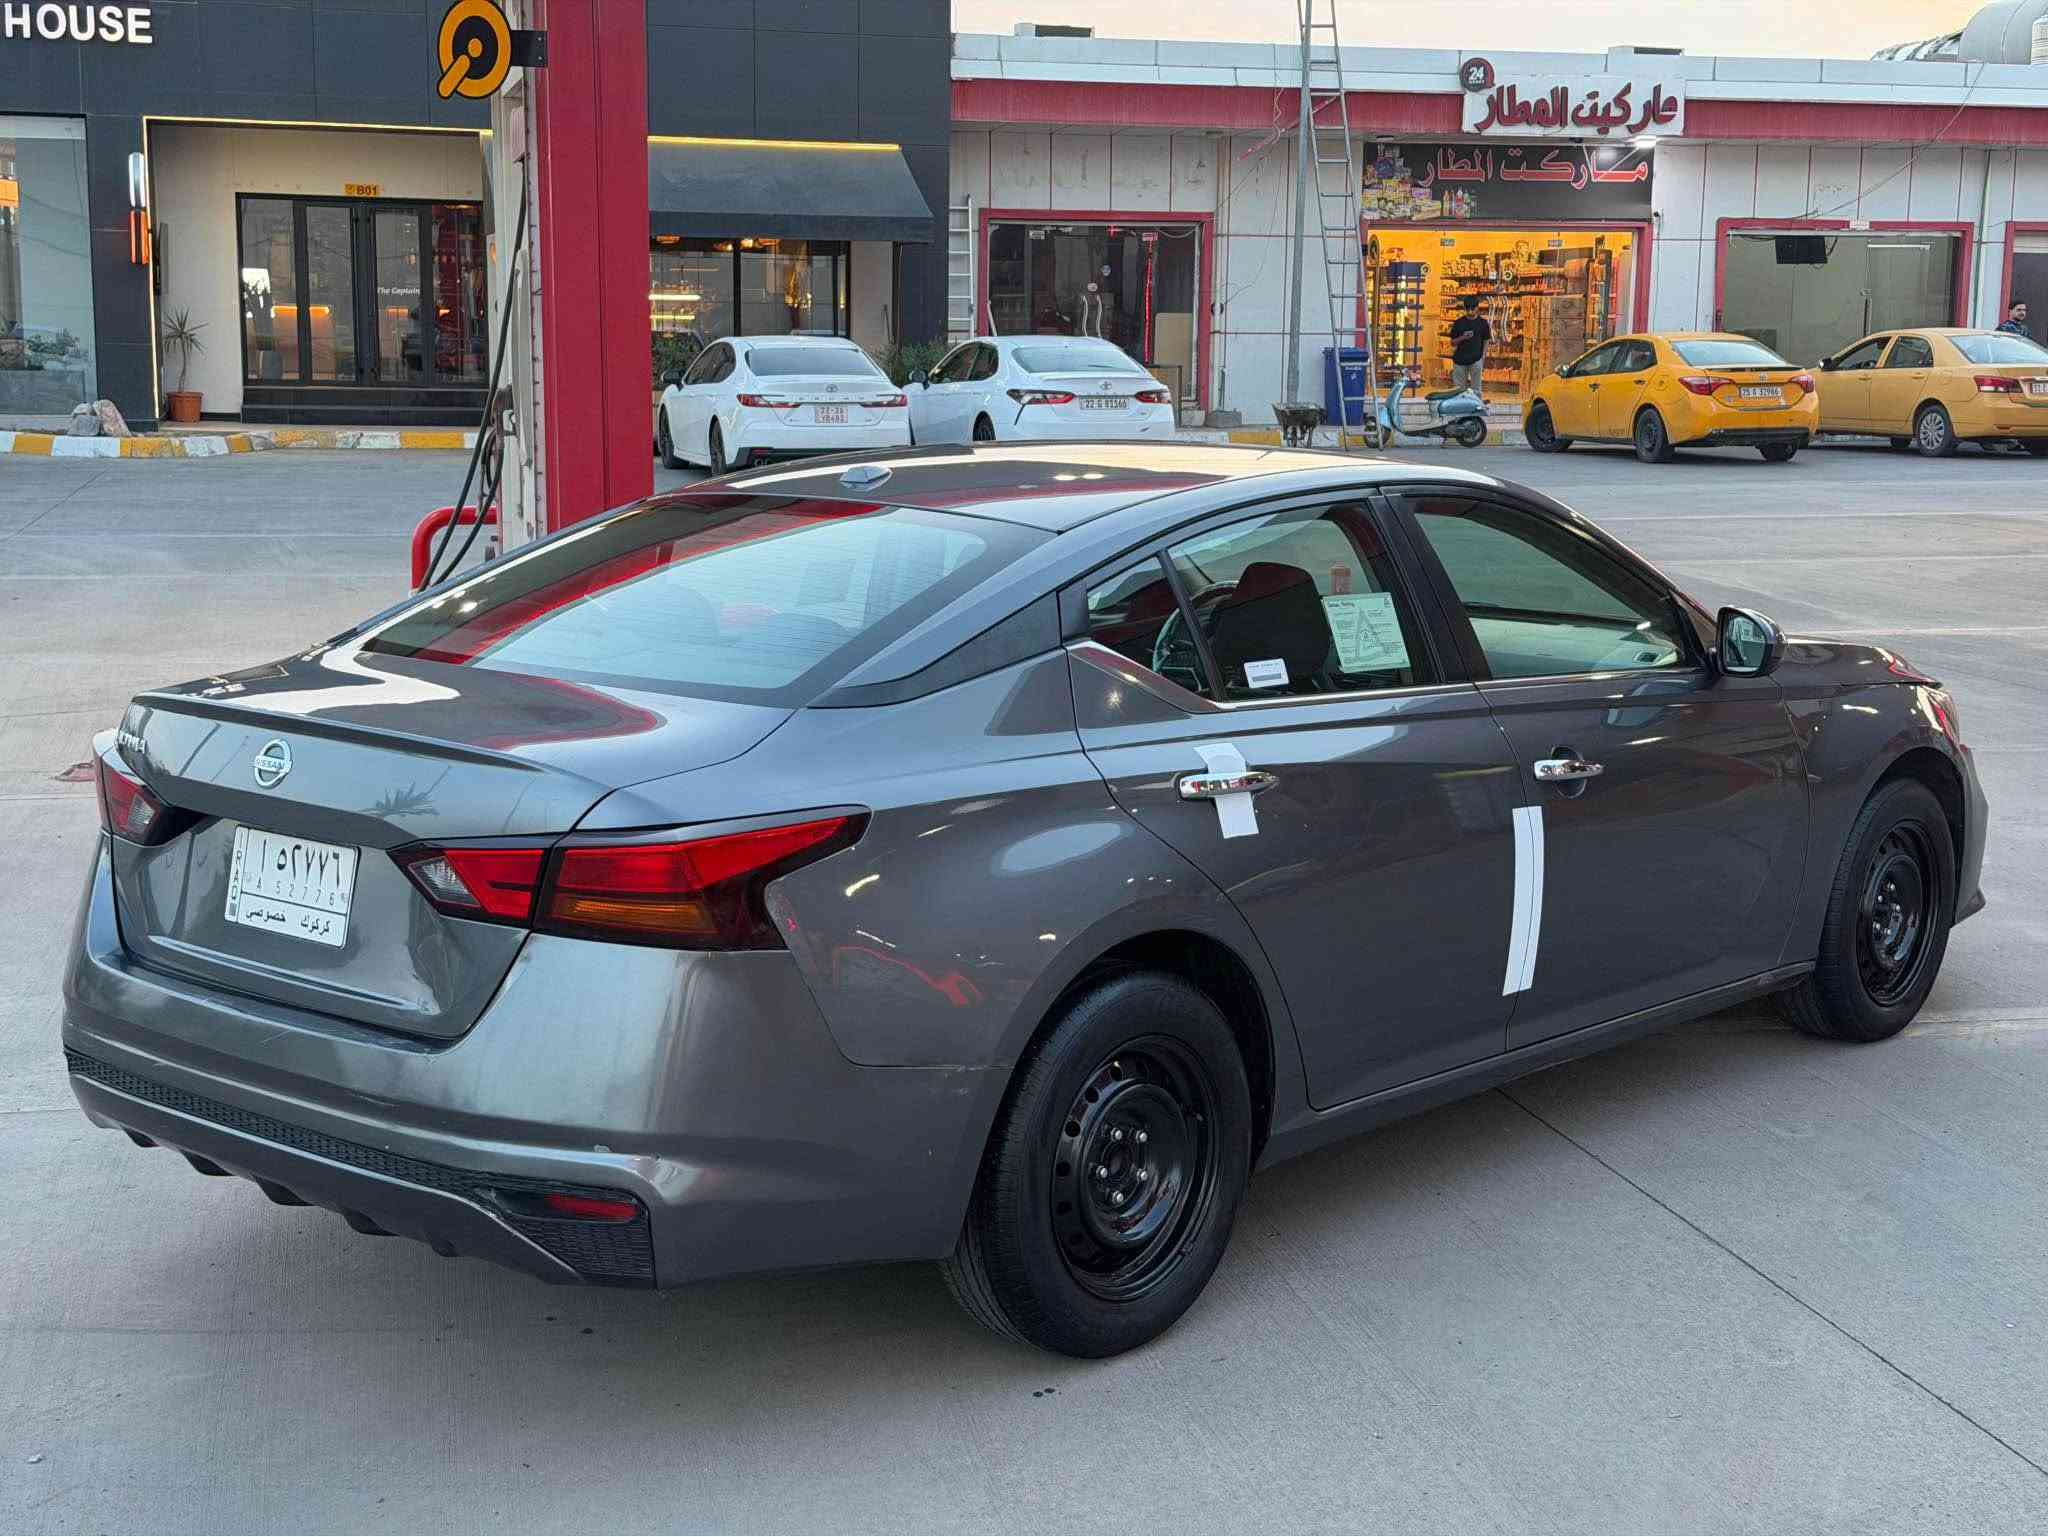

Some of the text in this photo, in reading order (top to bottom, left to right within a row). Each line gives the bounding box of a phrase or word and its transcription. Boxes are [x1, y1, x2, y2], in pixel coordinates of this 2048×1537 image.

[4, 2, 153, 43] HOUSE
[1469, 66, 1485, 80] 24
[1474, 82, 1678, 134] ماركيت المطار
[1418, 147, 1493, 188] المطار
[301, 912, 331, 936] كركوك
